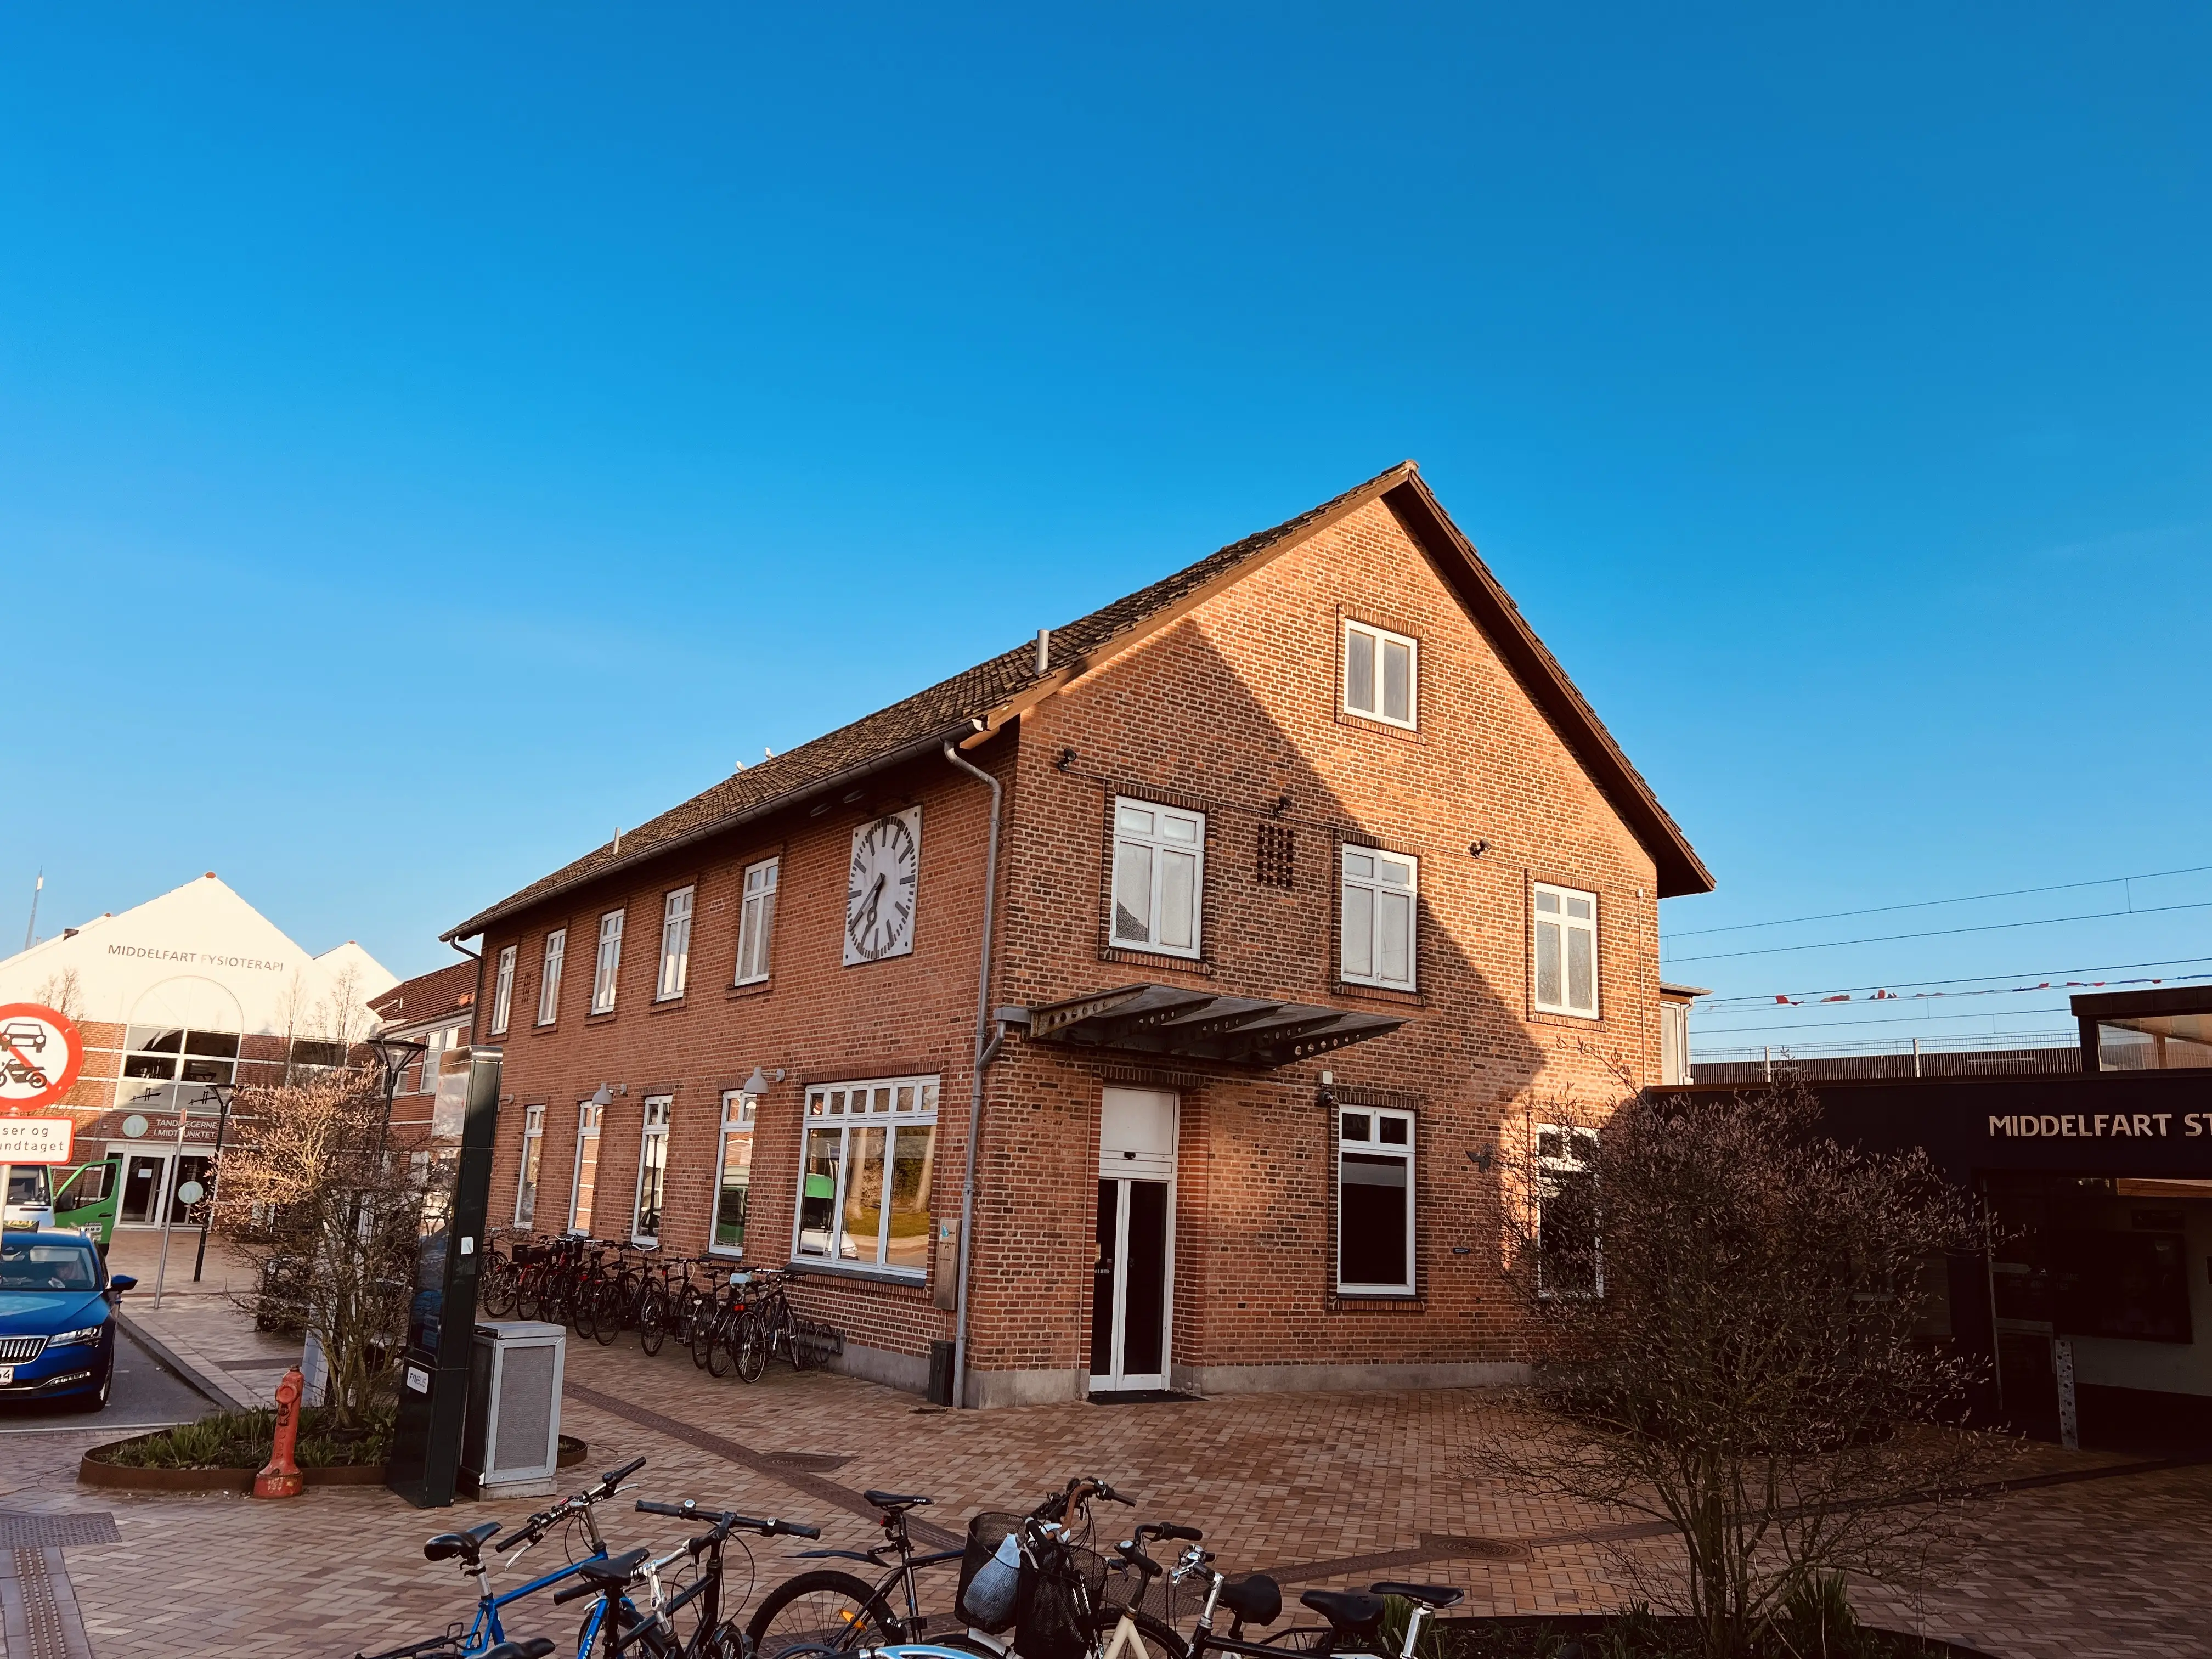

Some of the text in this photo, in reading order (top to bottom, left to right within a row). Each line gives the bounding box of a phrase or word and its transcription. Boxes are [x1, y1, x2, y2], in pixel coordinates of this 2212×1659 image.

[108, 945, 284, 972] MIDDELFART FYSIOTERAPI
[1989, 1114, 2172, 1136] MIDDELFART
[32, 1128, 48, 1137] og
[158, 1130, 216, 1138] MIDTUNKTET
[409, 1373, 426, 1387] FYNBUS
